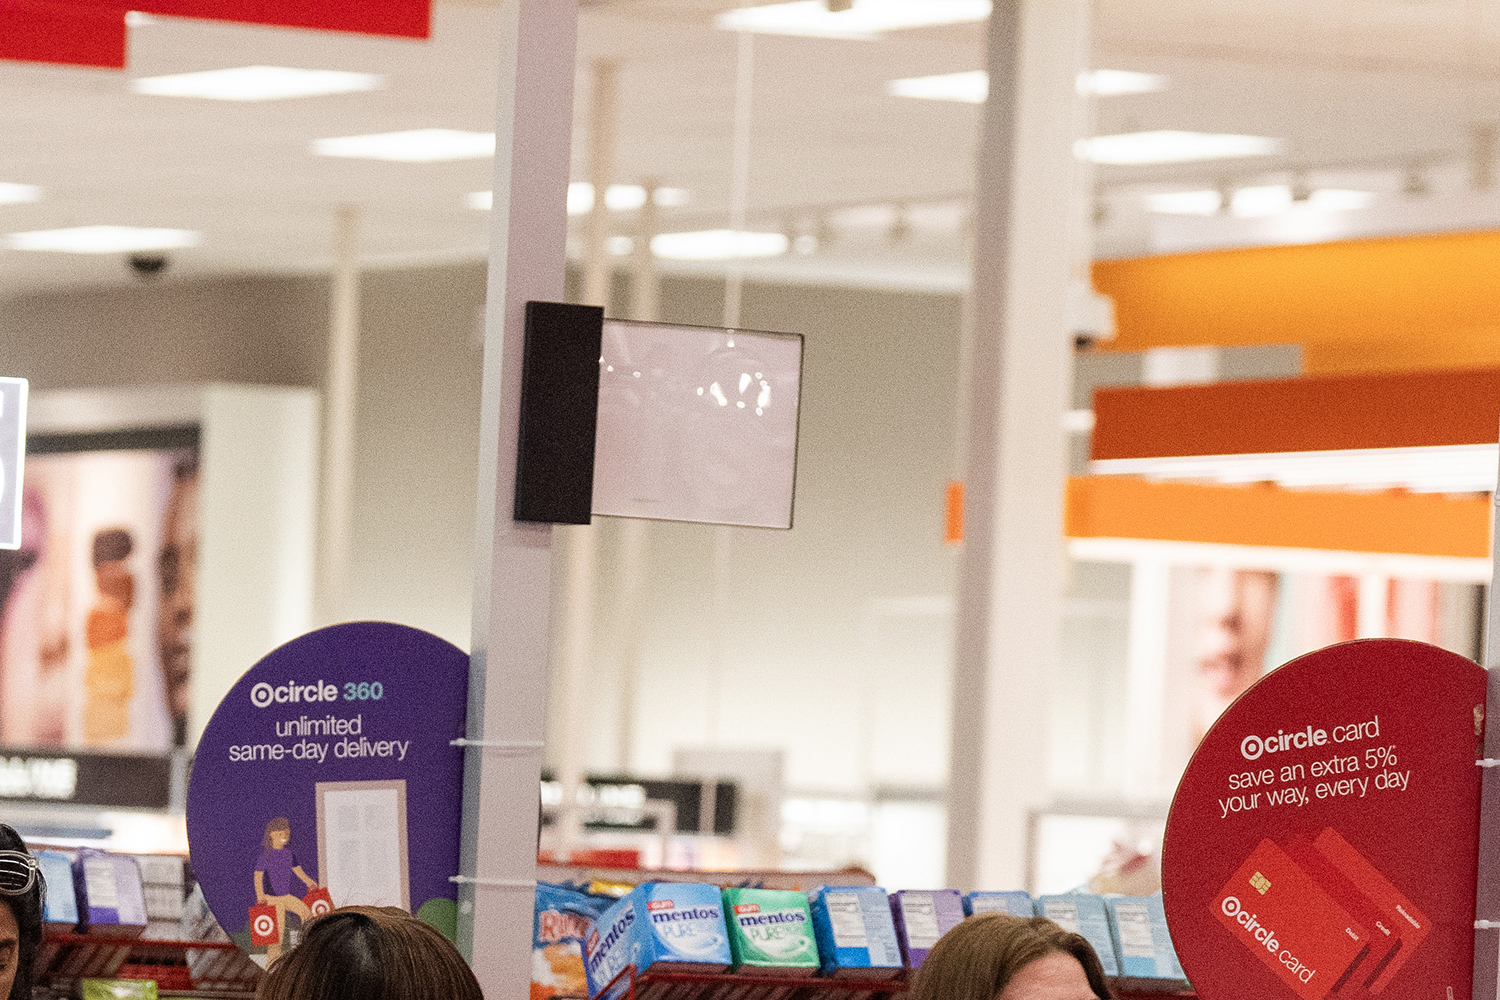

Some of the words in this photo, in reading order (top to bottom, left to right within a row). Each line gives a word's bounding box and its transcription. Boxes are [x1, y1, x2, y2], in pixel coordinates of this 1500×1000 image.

[274, 679, 339, 703] circle
[343, 681, 384, 702] 360
[275, 713, 362, 737] unlimited
[1263, 725, 1328, 753] circle
[1332, 715, 1380, 744] card
[228, 738, 329, 764] same-day
[333, 736, 410, 761] delivery
[1228, 768, 1275, 790] save
[1280, 763, 1305, 782] an
[1311, 755, 1360, 777] extra
[1218, 792, 1261, 819] your
[1266, 786, 1309, 808] way,
[1315, 776, 1369, 798] every
[1374, 769, 1411, 791] day
[652, 907, 719, 924] mentos
[739, 911, 806, 926] mentos
[590, 909, 635, 974] mentos
[1236, 914, 1280, 953] circle
[1278, 949, 1316, 984] card
